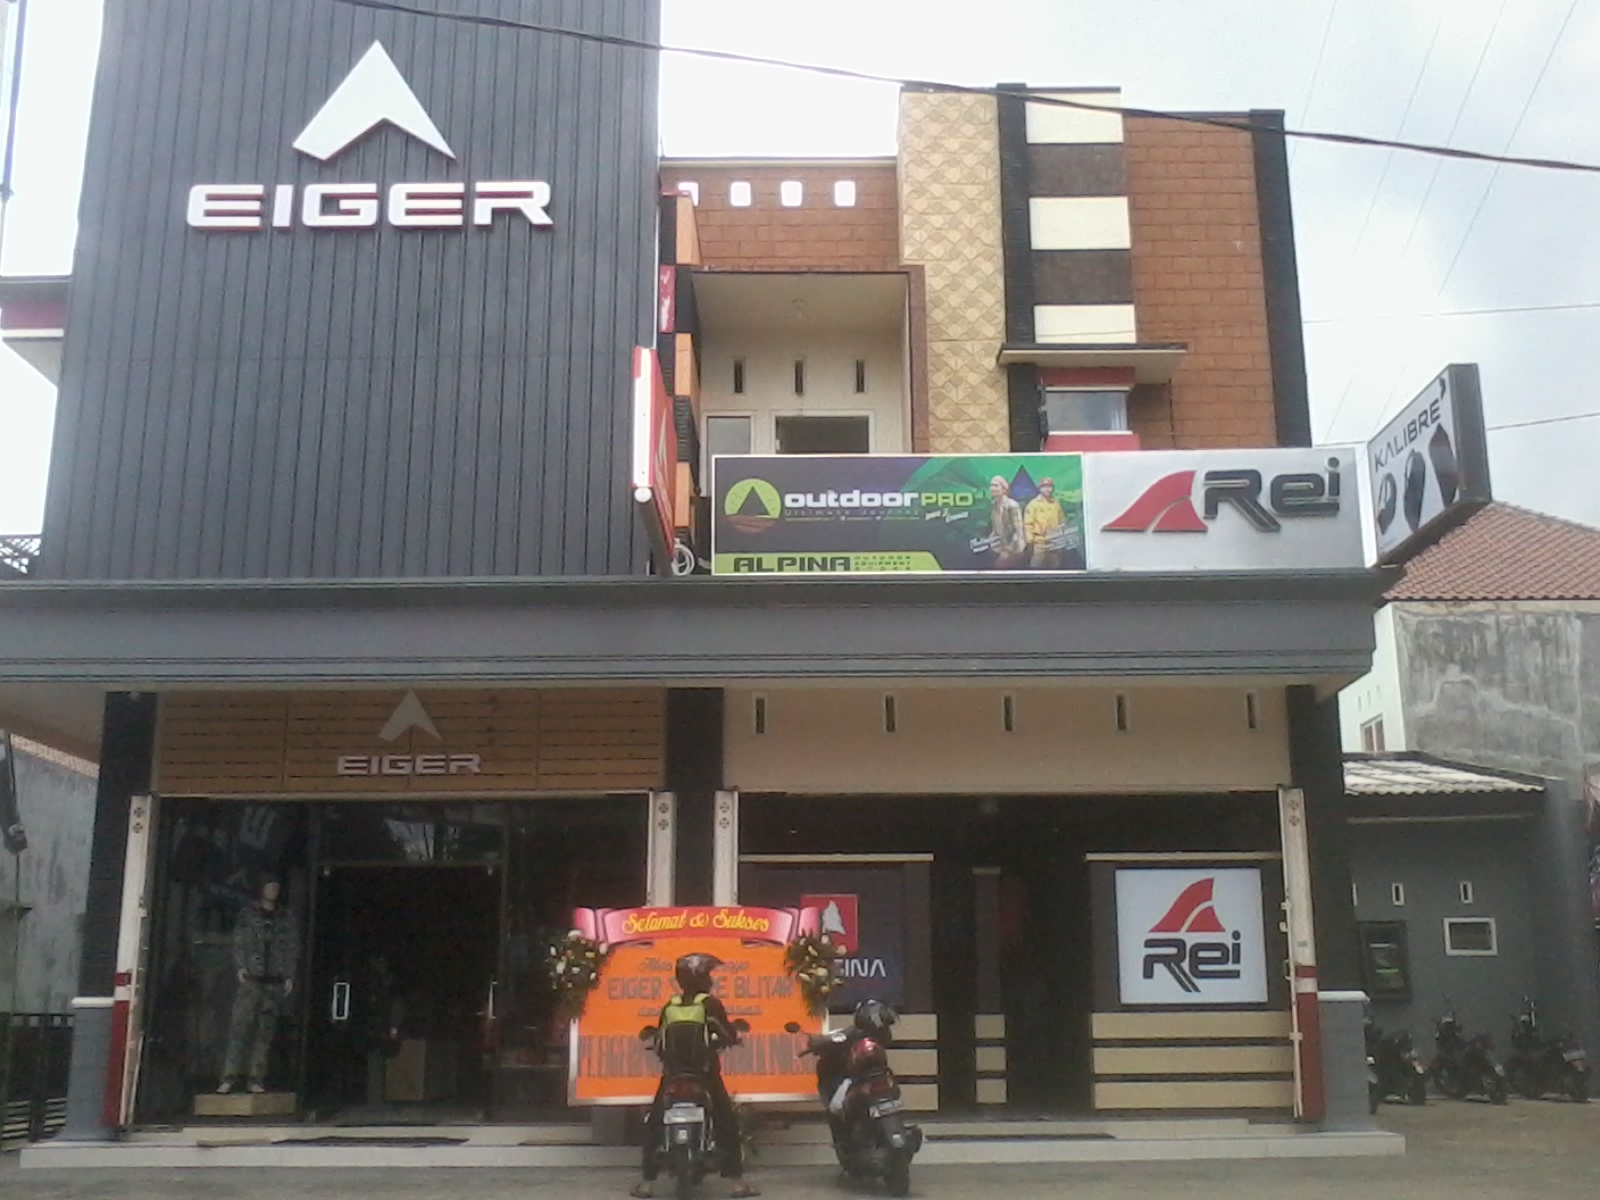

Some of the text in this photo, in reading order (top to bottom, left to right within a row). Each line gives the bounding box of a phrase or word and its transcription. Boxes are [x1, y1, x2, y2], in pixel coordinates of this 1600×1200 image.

[187, 181, 554, 231] EIGER
[1374, 398, 1441, 473] KALIBRE
[1202, 456, 1341, 533] Rei
[733, 556, 850, 572] ALPINA
[337, 753, 482, 776] EIGER
[621, 908, 688, 934] Selamat
[712, 907, 770, 933] Sukses
[1142, 930, 1242, 993] Rei
[608, 976, 663, 1000] EIGER
